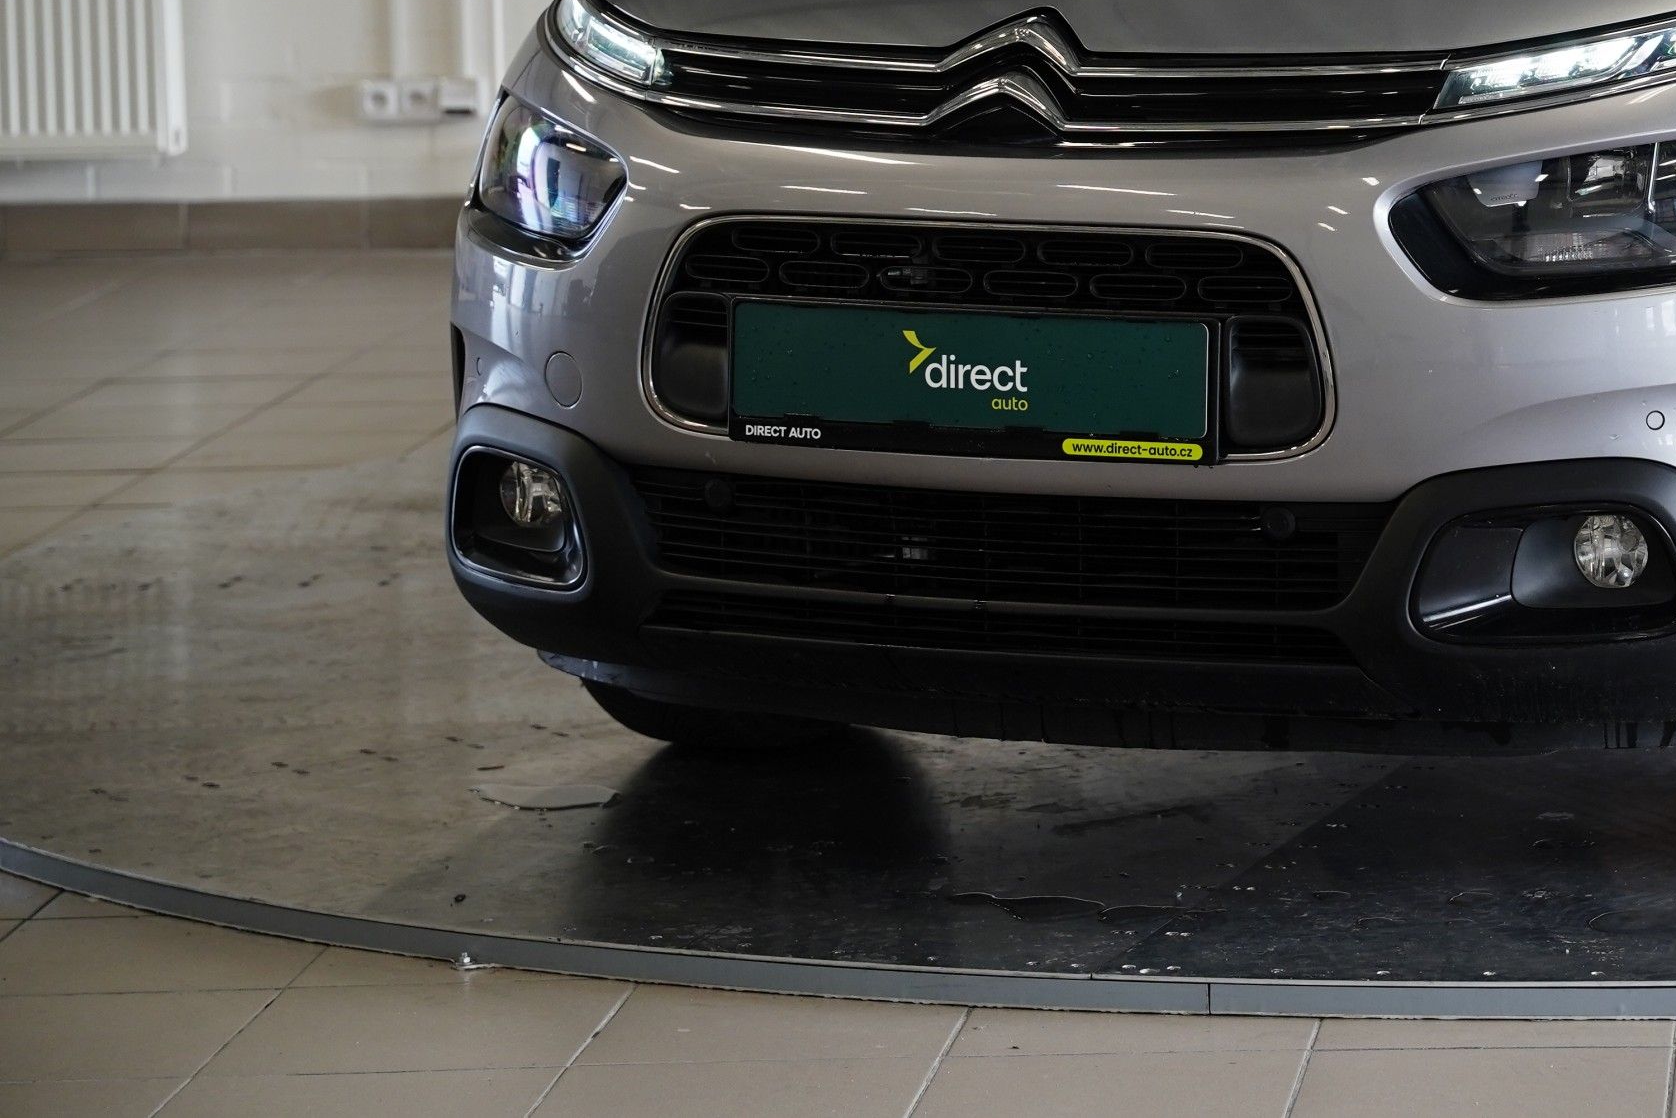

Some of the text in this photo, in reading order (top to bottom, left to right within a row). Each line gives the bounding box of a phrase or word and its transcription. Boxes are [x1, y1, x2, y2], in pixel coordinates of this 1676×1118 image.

[925, 354, 1028, 392] direct
[991, 396, 1028, 411] auto
[745, 424, 822, 439] DIRECT AUTO
[1072, 442, 1193, 457] www.direct-auto.cz
